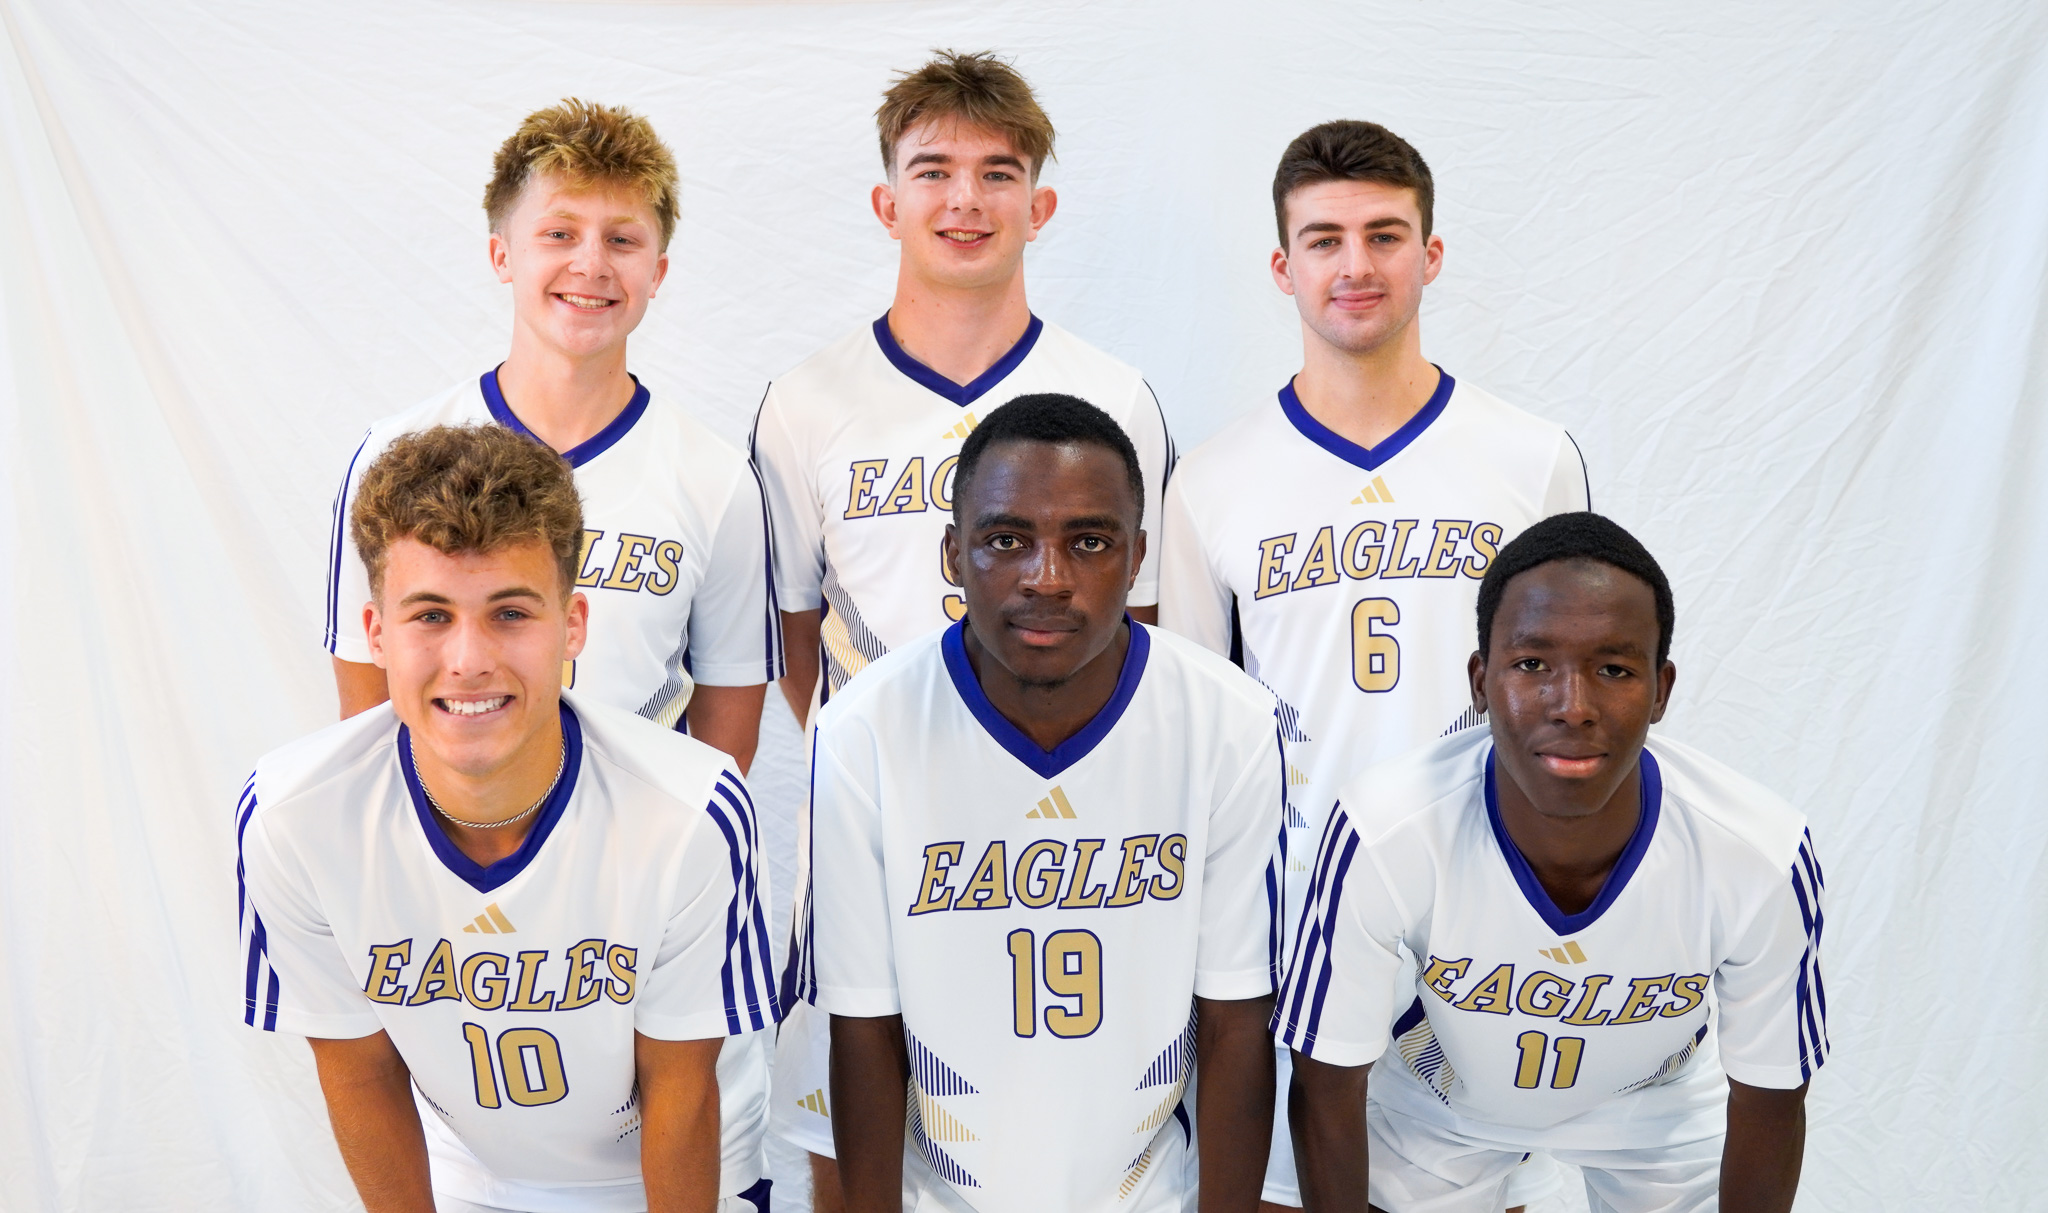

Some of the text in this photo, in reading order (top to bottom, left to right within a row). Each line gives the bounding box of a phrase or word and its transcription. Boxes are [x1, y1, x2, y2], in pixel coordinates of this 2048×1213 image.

[575, 529, 684, 596] LES
[1254, 519, 1503, 601] EAGLES
[1351, 597, 1401, 694] 6
[907, 833, 1188, 917] EAGLES
[361, 937, 638, 1013] EAGLES
[1006, 927, 1104, 1040] 19
[1423, 954, 1711, 1027] EAGLES
[462, 1021, 570, 1110] 10
[1513, 1029, 1586, 1090] 11
